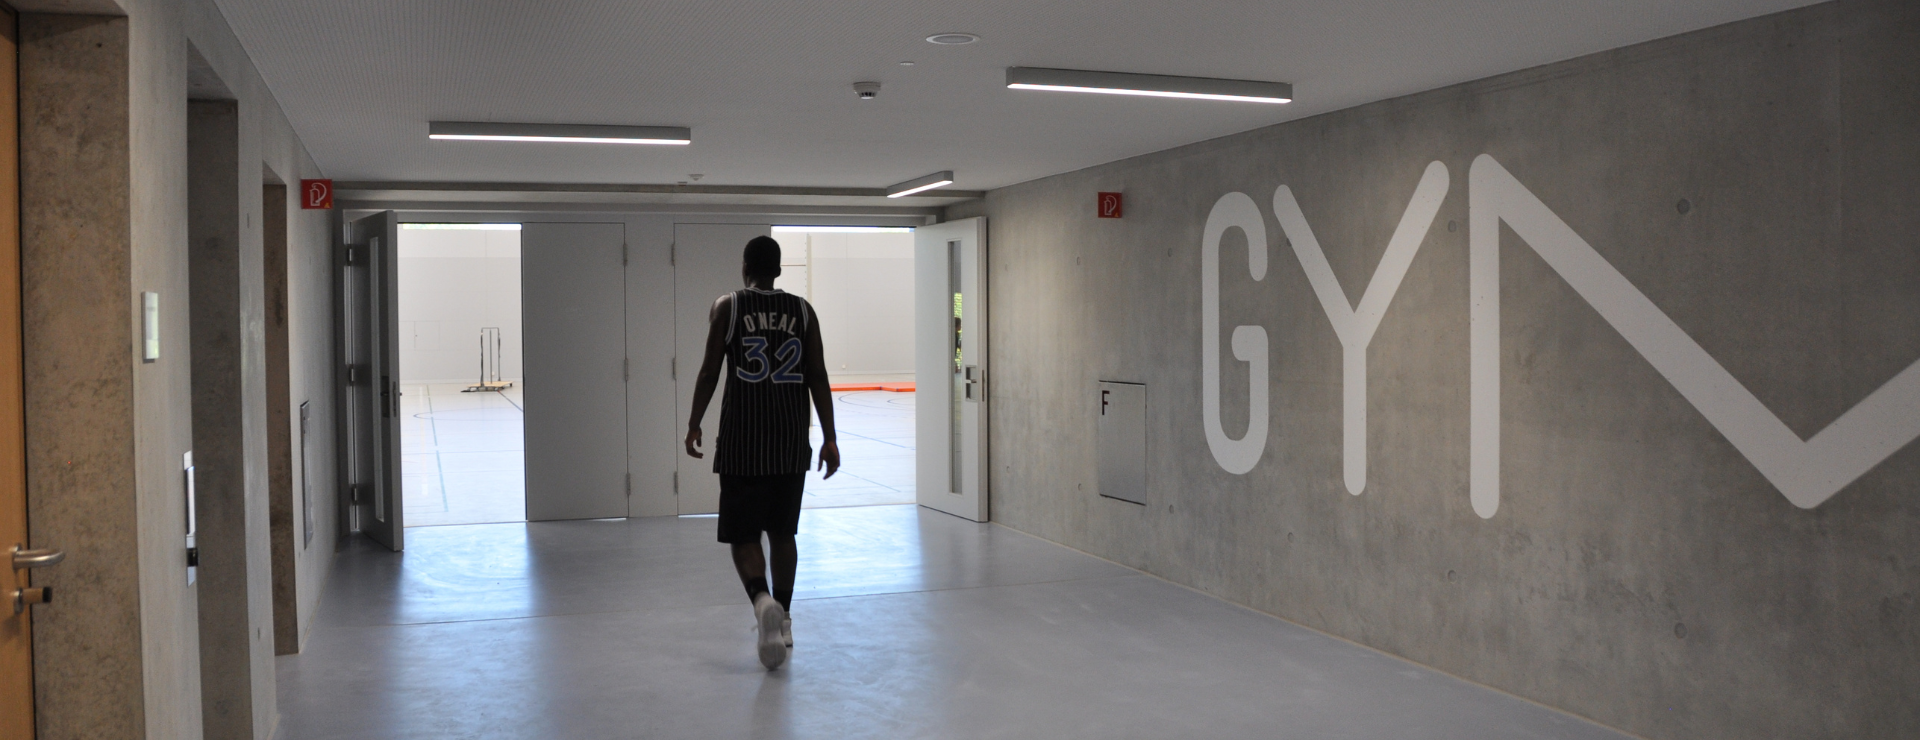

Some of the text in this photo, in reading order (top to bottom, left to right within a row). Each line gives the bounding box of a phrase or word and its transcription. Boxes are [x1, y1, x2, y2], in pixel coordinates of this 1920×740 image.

[743, 312, 797, 335] O'NEAL
[736, 336, 804, 384] 32
[1101, 390, 1110, 415] F
